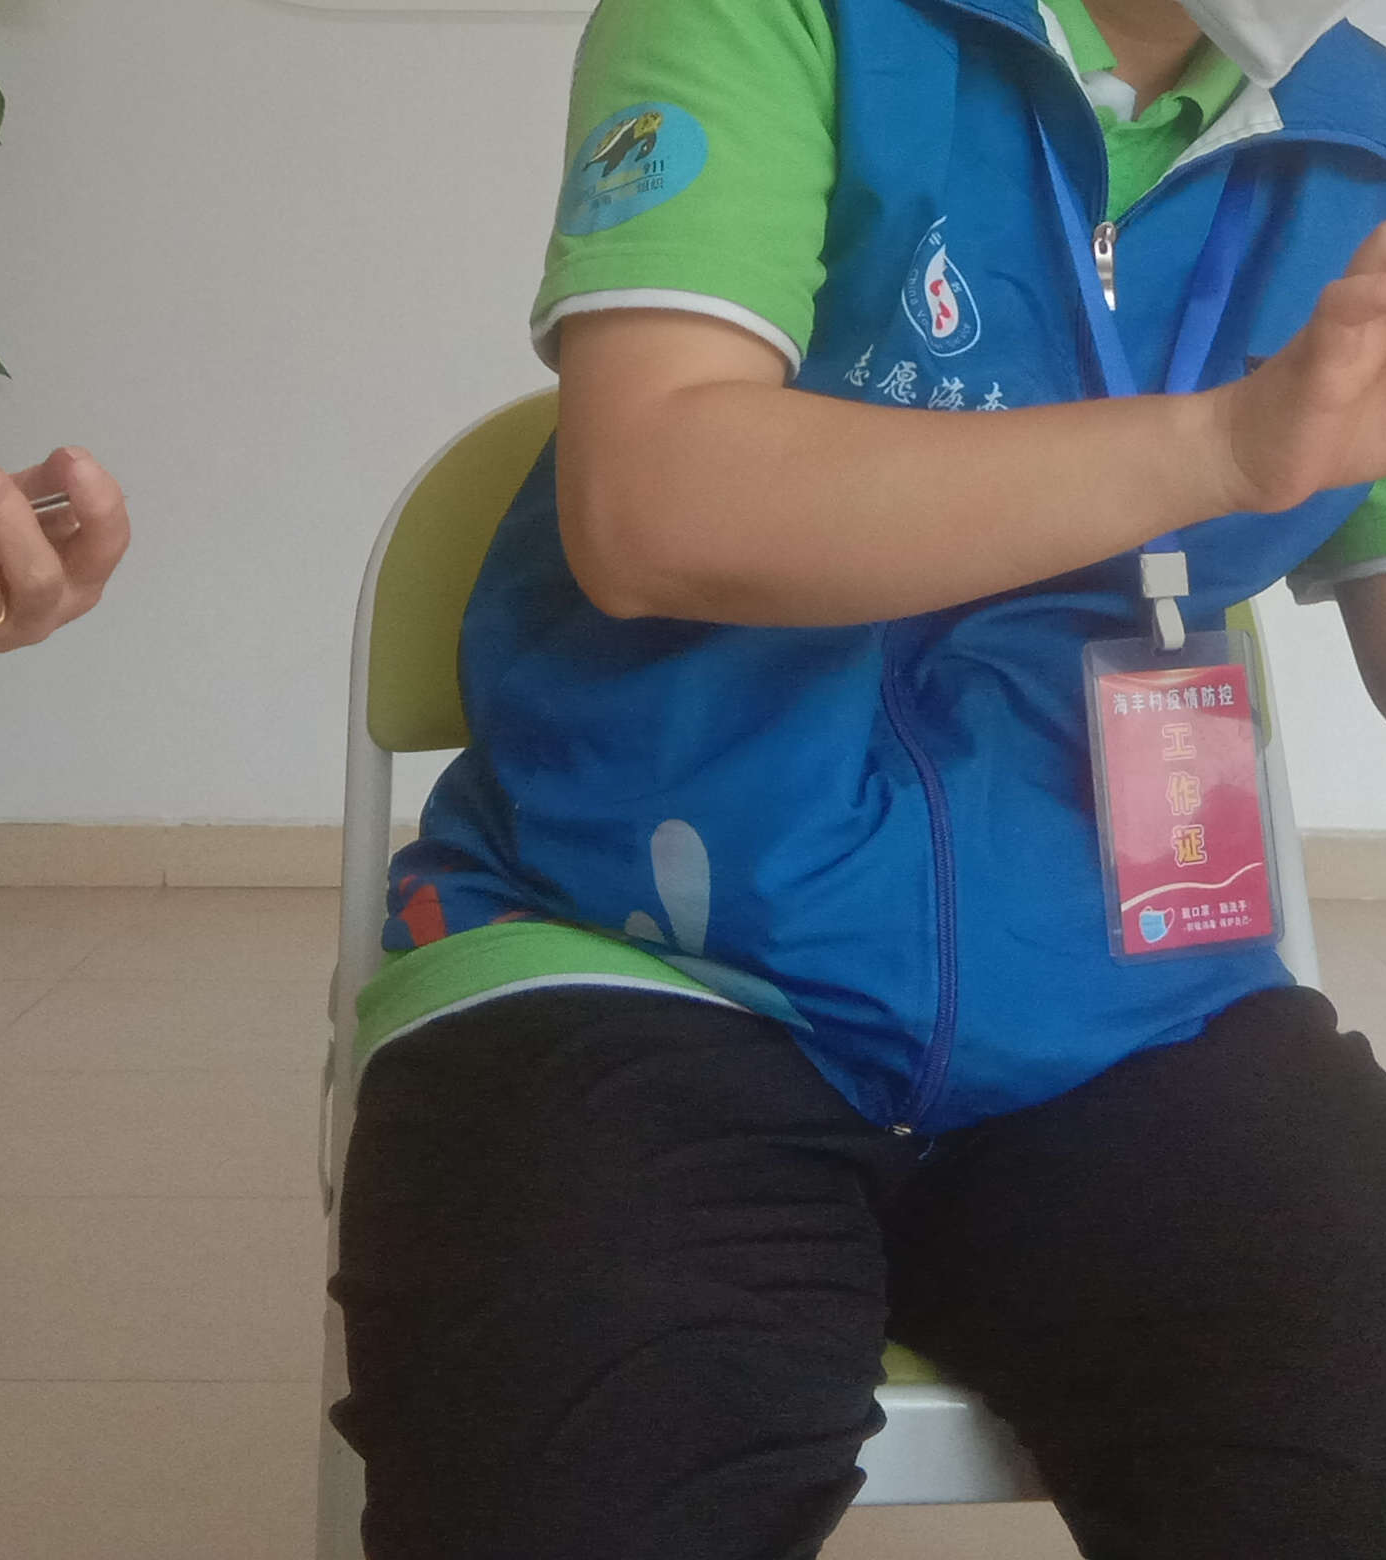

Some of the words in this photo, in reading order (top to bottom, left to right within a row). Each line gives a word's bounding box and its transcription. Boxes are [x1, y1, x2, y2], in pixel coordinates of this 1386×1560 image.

[1112, 684, 1235, 715] 海丰村疫情防控
[1162, 722, 1207, 867] 工作证
